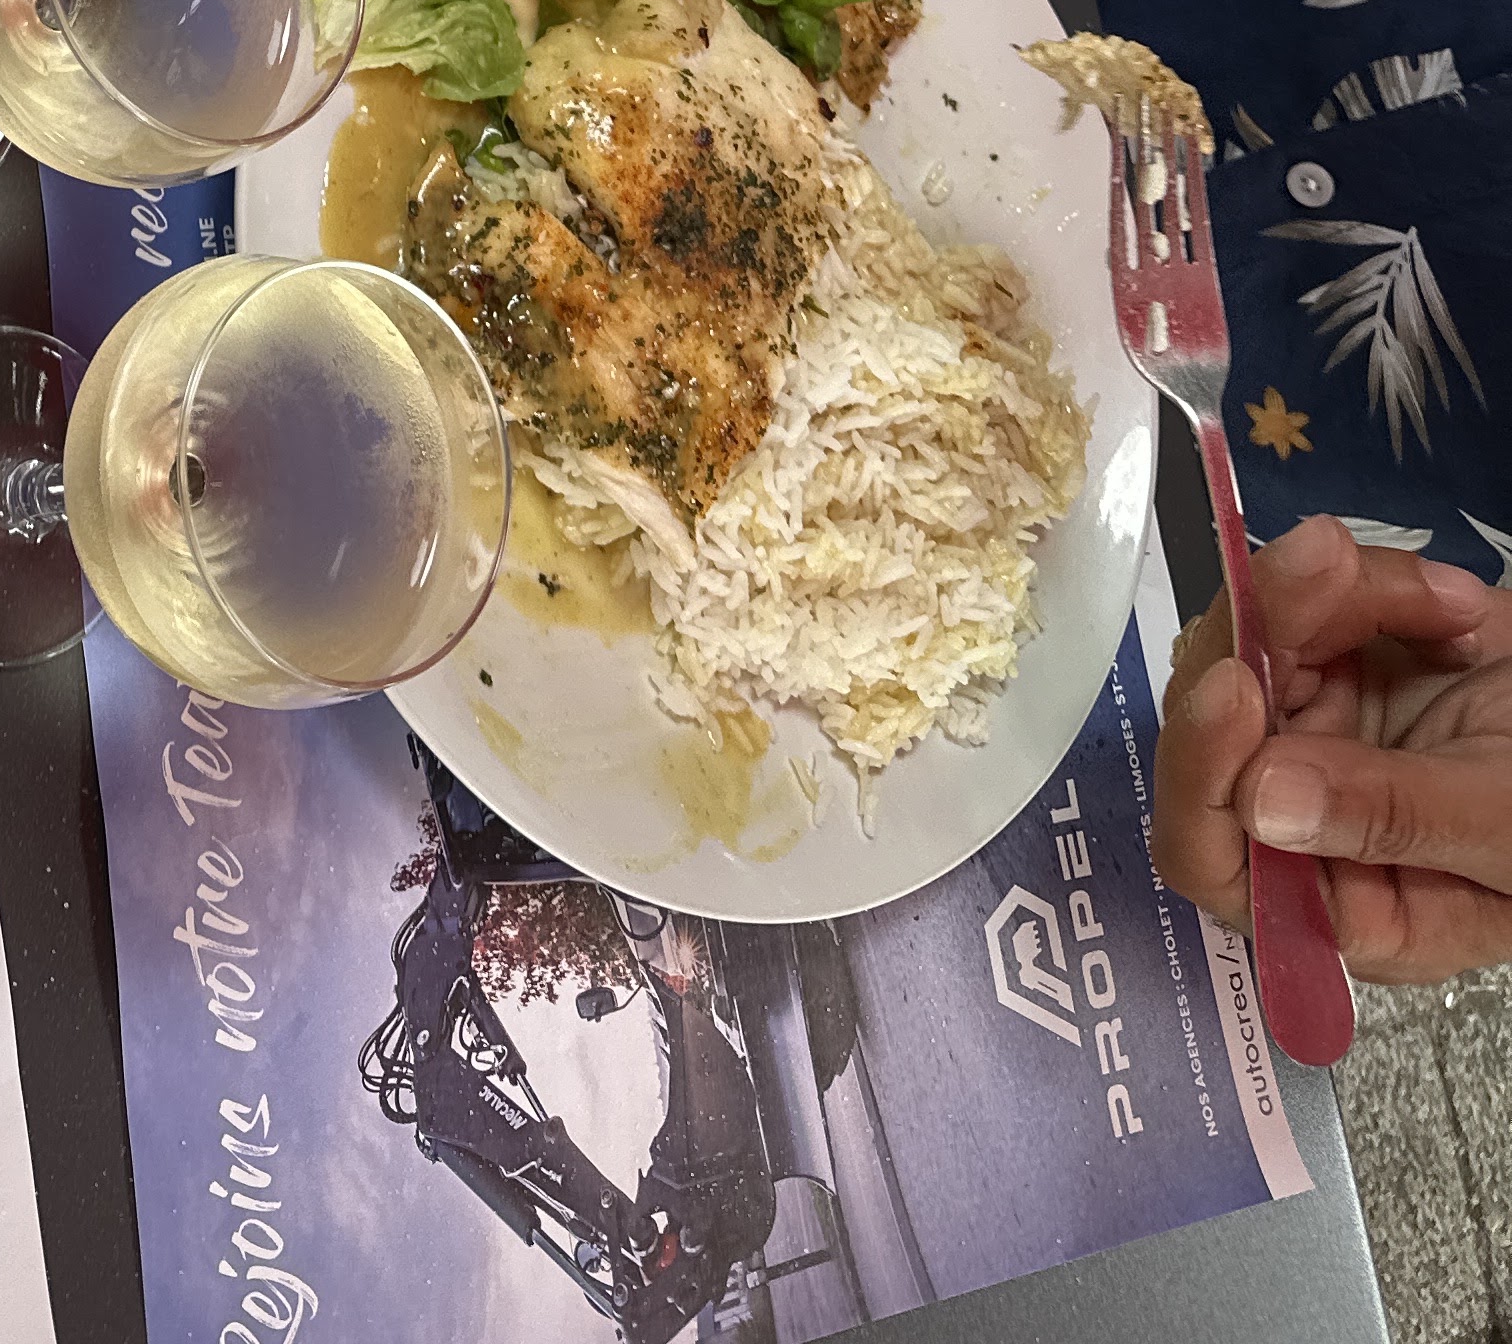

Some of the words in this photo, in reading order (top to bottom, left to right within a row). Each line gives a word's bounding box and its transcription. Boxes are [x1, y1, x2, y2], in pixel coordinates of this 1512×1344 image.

[154, 675, 243, 828] Tea
[1118, 716, 1147, 800] LIMOGES
[176, 837, 264, 1053] notre
[1051, 777, 1144, 1145] PROPEL
[1156, 904, 1183, 980] CHOLET
[1215, 947, 1240, 969] /
[1175, 992, 1207, 1088] AGENCES
[1223, 970, 1274, 1118] autocrea
[1196, 1091, 1219, 1136] NOS
